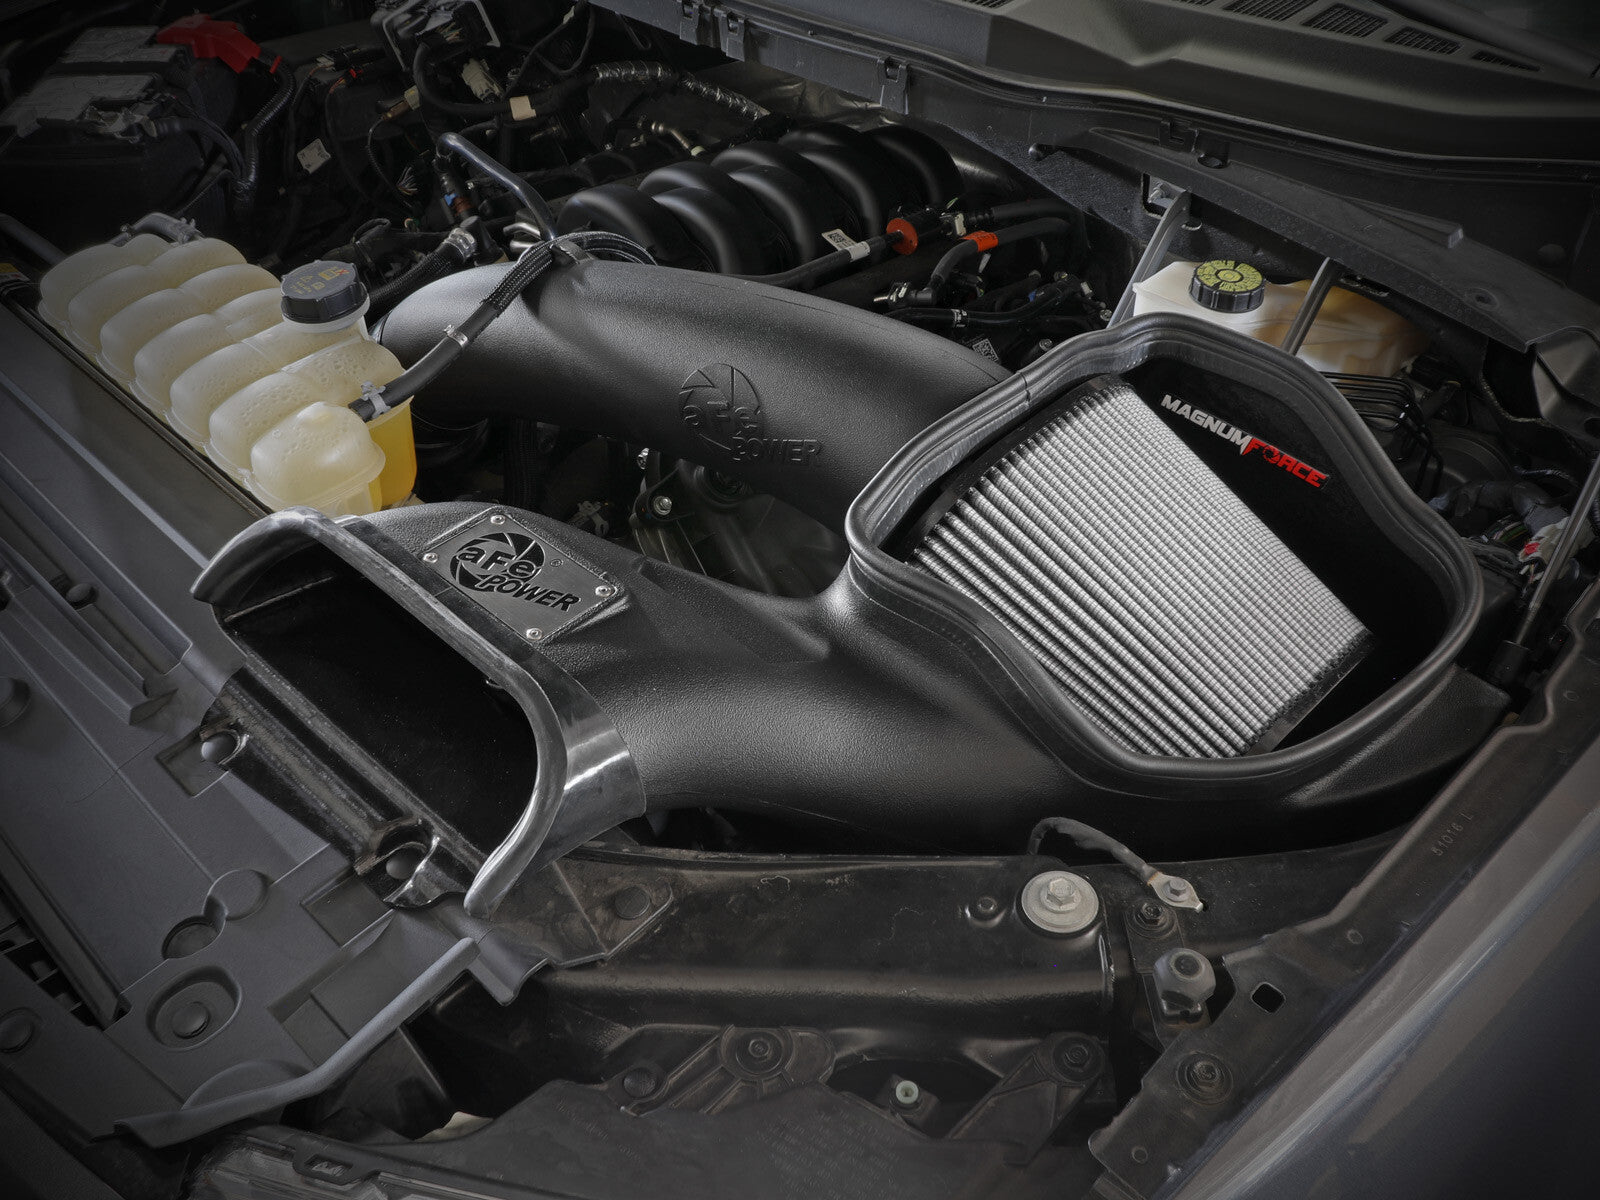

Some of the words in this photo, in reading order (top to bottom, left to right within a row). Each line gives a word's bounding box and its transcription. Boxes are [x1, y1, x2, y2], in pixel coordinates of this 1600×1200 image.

[730, 435, 824, 467] POWER
[456, 546, 537, 579] aFe
[475, 574, 582, 612] POWER
